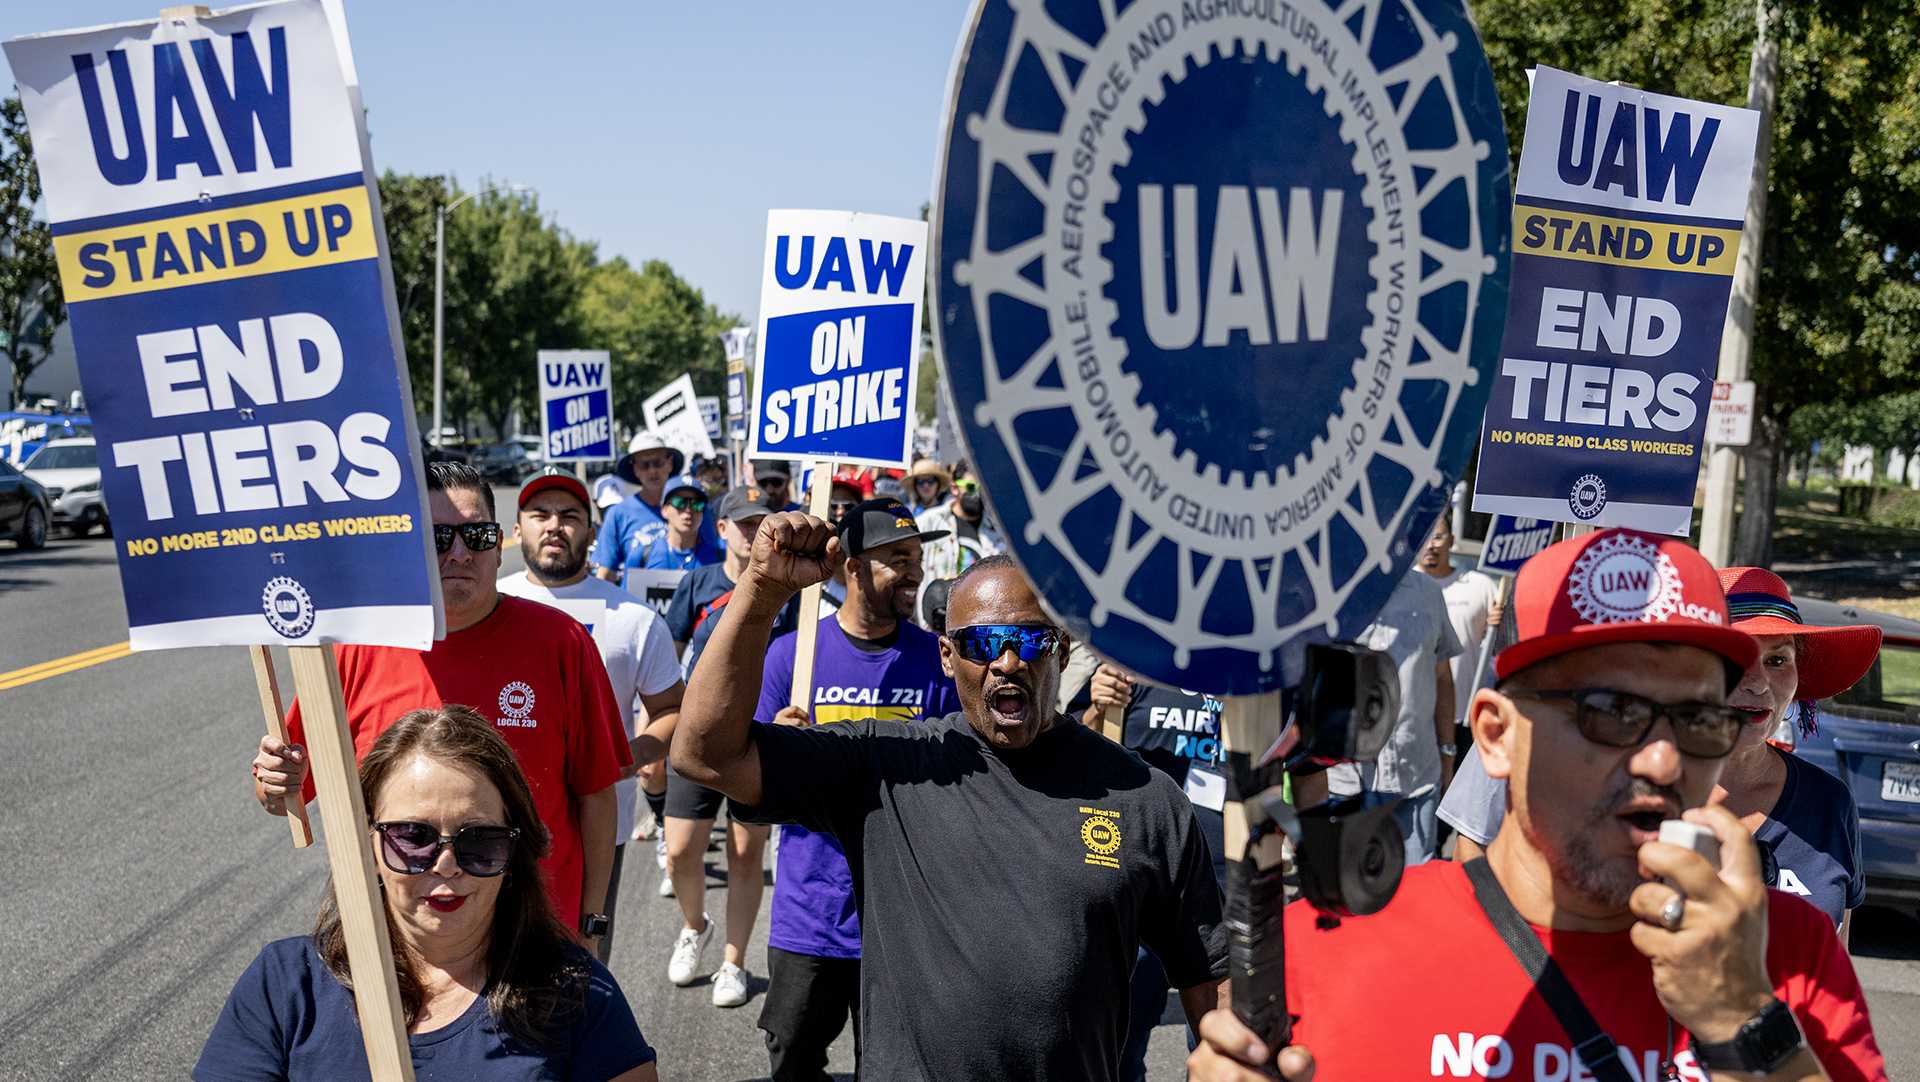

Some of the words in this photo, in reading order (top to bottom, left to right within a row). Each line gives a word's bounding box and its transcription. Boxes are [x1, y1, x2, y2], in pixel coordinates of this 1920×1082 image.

[1128, 12, 1176, 72] AND
[1182, 0, 1338, 78] AGRICULTURAL
[70, 26, 293, 186] UAW
[1061, 61, 1131, 279] AEROSPACE
[1340, 70, 1404, 249] IMPLEMENT
[1557, 88, 1721, 207] UAW
[79, 219, 266, 288] STAND
[283, 203, 353, 257] UP
[1522, 215, 1653, 260] STAND
[1666, 233, 1725, 266] UP
[774, 235, 914, 297] UAW
[1137, 184, 1344, 350] UAW
[809, 315, 866, 375] ON
[1361, 260, 1407, 419] WORKERS
[1535, 286, 1682, 357] END
[136, 312, 344, 418] END
[545, 363, 603, 387] UAW
[565, 396, 590, 425] ON
[764, 367, 903, 445] STRIKE
[1501, 358, 1701, 432] TIERS
[550, 416, 608, 456] STRIKE
[1344, 422, 1367, 466] OF
[1491, 430, 1513, 443] NO
[1514, 431, 1554, 446] MORE
[1556, 435, 1583, 449] 2ND
[1586, 437, 1628, 451] CLASS
[1631, 441, 1694, 457] WORKERS
[112, 412, 402, 522] TIERS
[1168, 493, 1255, 540] UNITED
[1264, 456, 1343, 536] AMERICA
[1579, 490, 1596, 501] UAW
[127, 539, 158, 557] NO
[161, 531, 219, 553] MORE
[222, 527, 257, 546] 2ND
[259, 521, 321, 543] CLASS
[323, 514, 413, 536] WORKERS
[1487, 528, 1550, 564] STRIKE
[276, 599, 297, 613] UAW
[1601, 570, 1650, 593] UAW
[509, 695, 525, 704] UAW
[815, 686, 883, 704] LOCAL
[890, 688, 923, 705] 721
[1149, 706, 1215, 734] FAIR
[497, 718, 520, 727] LOCAL
[521, 719, 537, 728] 230
[1092, 829, 1110, 840] UAW
[1094, 808, 1108, 817] Local
[1430, 1032, 1513, 1078] NO
